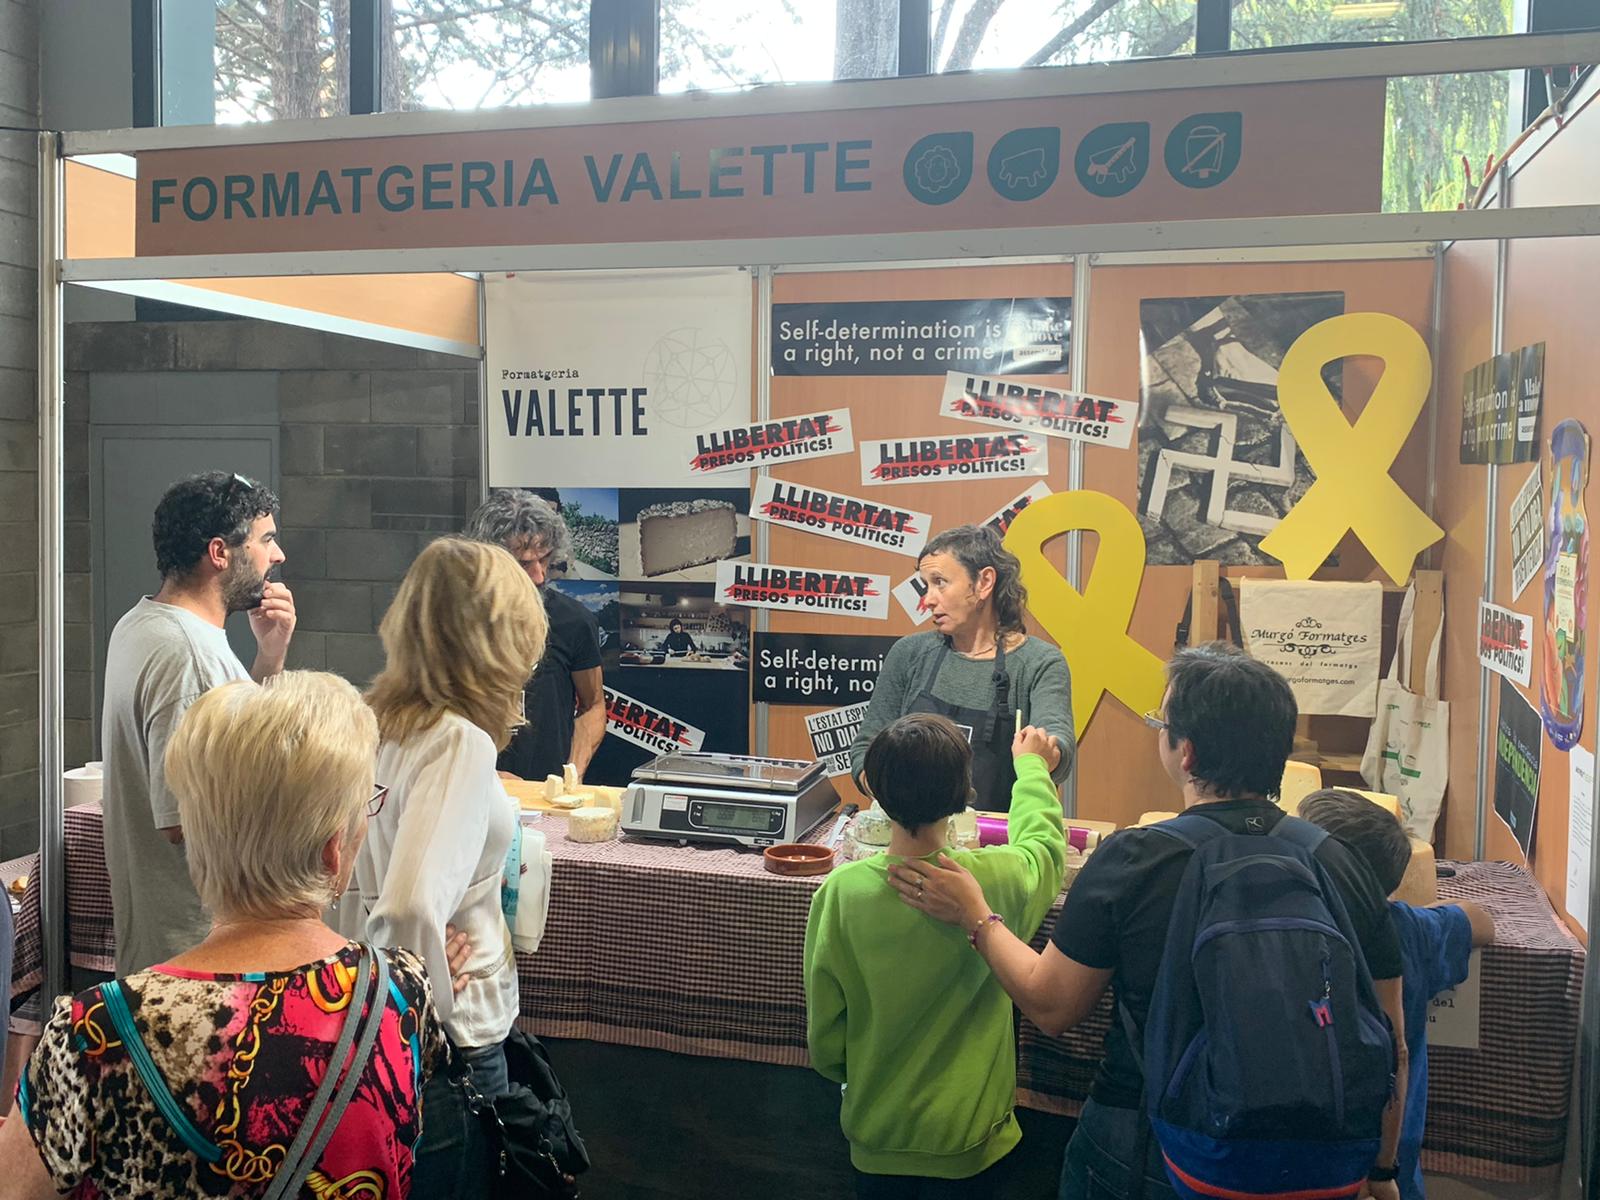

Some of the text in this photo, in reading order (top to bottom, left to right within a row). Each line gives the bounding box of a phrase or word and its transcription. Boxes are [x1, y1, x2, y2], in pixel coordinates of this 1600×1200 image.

[152, 140, 873, 223] FORMATGERIA VALETTE
[780, 319, 1000, 341] Self-determination is
[784, 341, 995, 367] a right, not a crime
[502, 368, 579, 380] Formatgeria
[502, 388, 648, 436] VALETTE
[962, 401, 1022, 423] PRESOS
[965, 377, 1114, 423] LLIBERTAT
[696, 415, 830, 455] LLIBERTAT
[700, 451, 755, 469] PRESOS
[880, 434, 1025, 464] LLIBERTAT
[881, 463, 941, 479] PRESOS
[769, 504, 826, 529] PRESOS
[772, 483, 911, 532] LLIBERTAT
[735, 565, 869, 597] LLIBERTAT
[733, 588, 789, 604] PRESOS
[1250, 629, 1368, 645] Murgó Formatges
[760, 648, 884, 671] Self-determi
[765, 670, 878, 695] a right, no
[1287, 676, 1356, 685] rgoformatges.com
[603, 690, 688, 742] BERTAT
[808, 705, 869, 732] L'ESTAT ESPA
[814, 723, 860, 753] NO DIA
[835, 752, 851, 771] SE
[1432, 998, 1455, 1008] del
